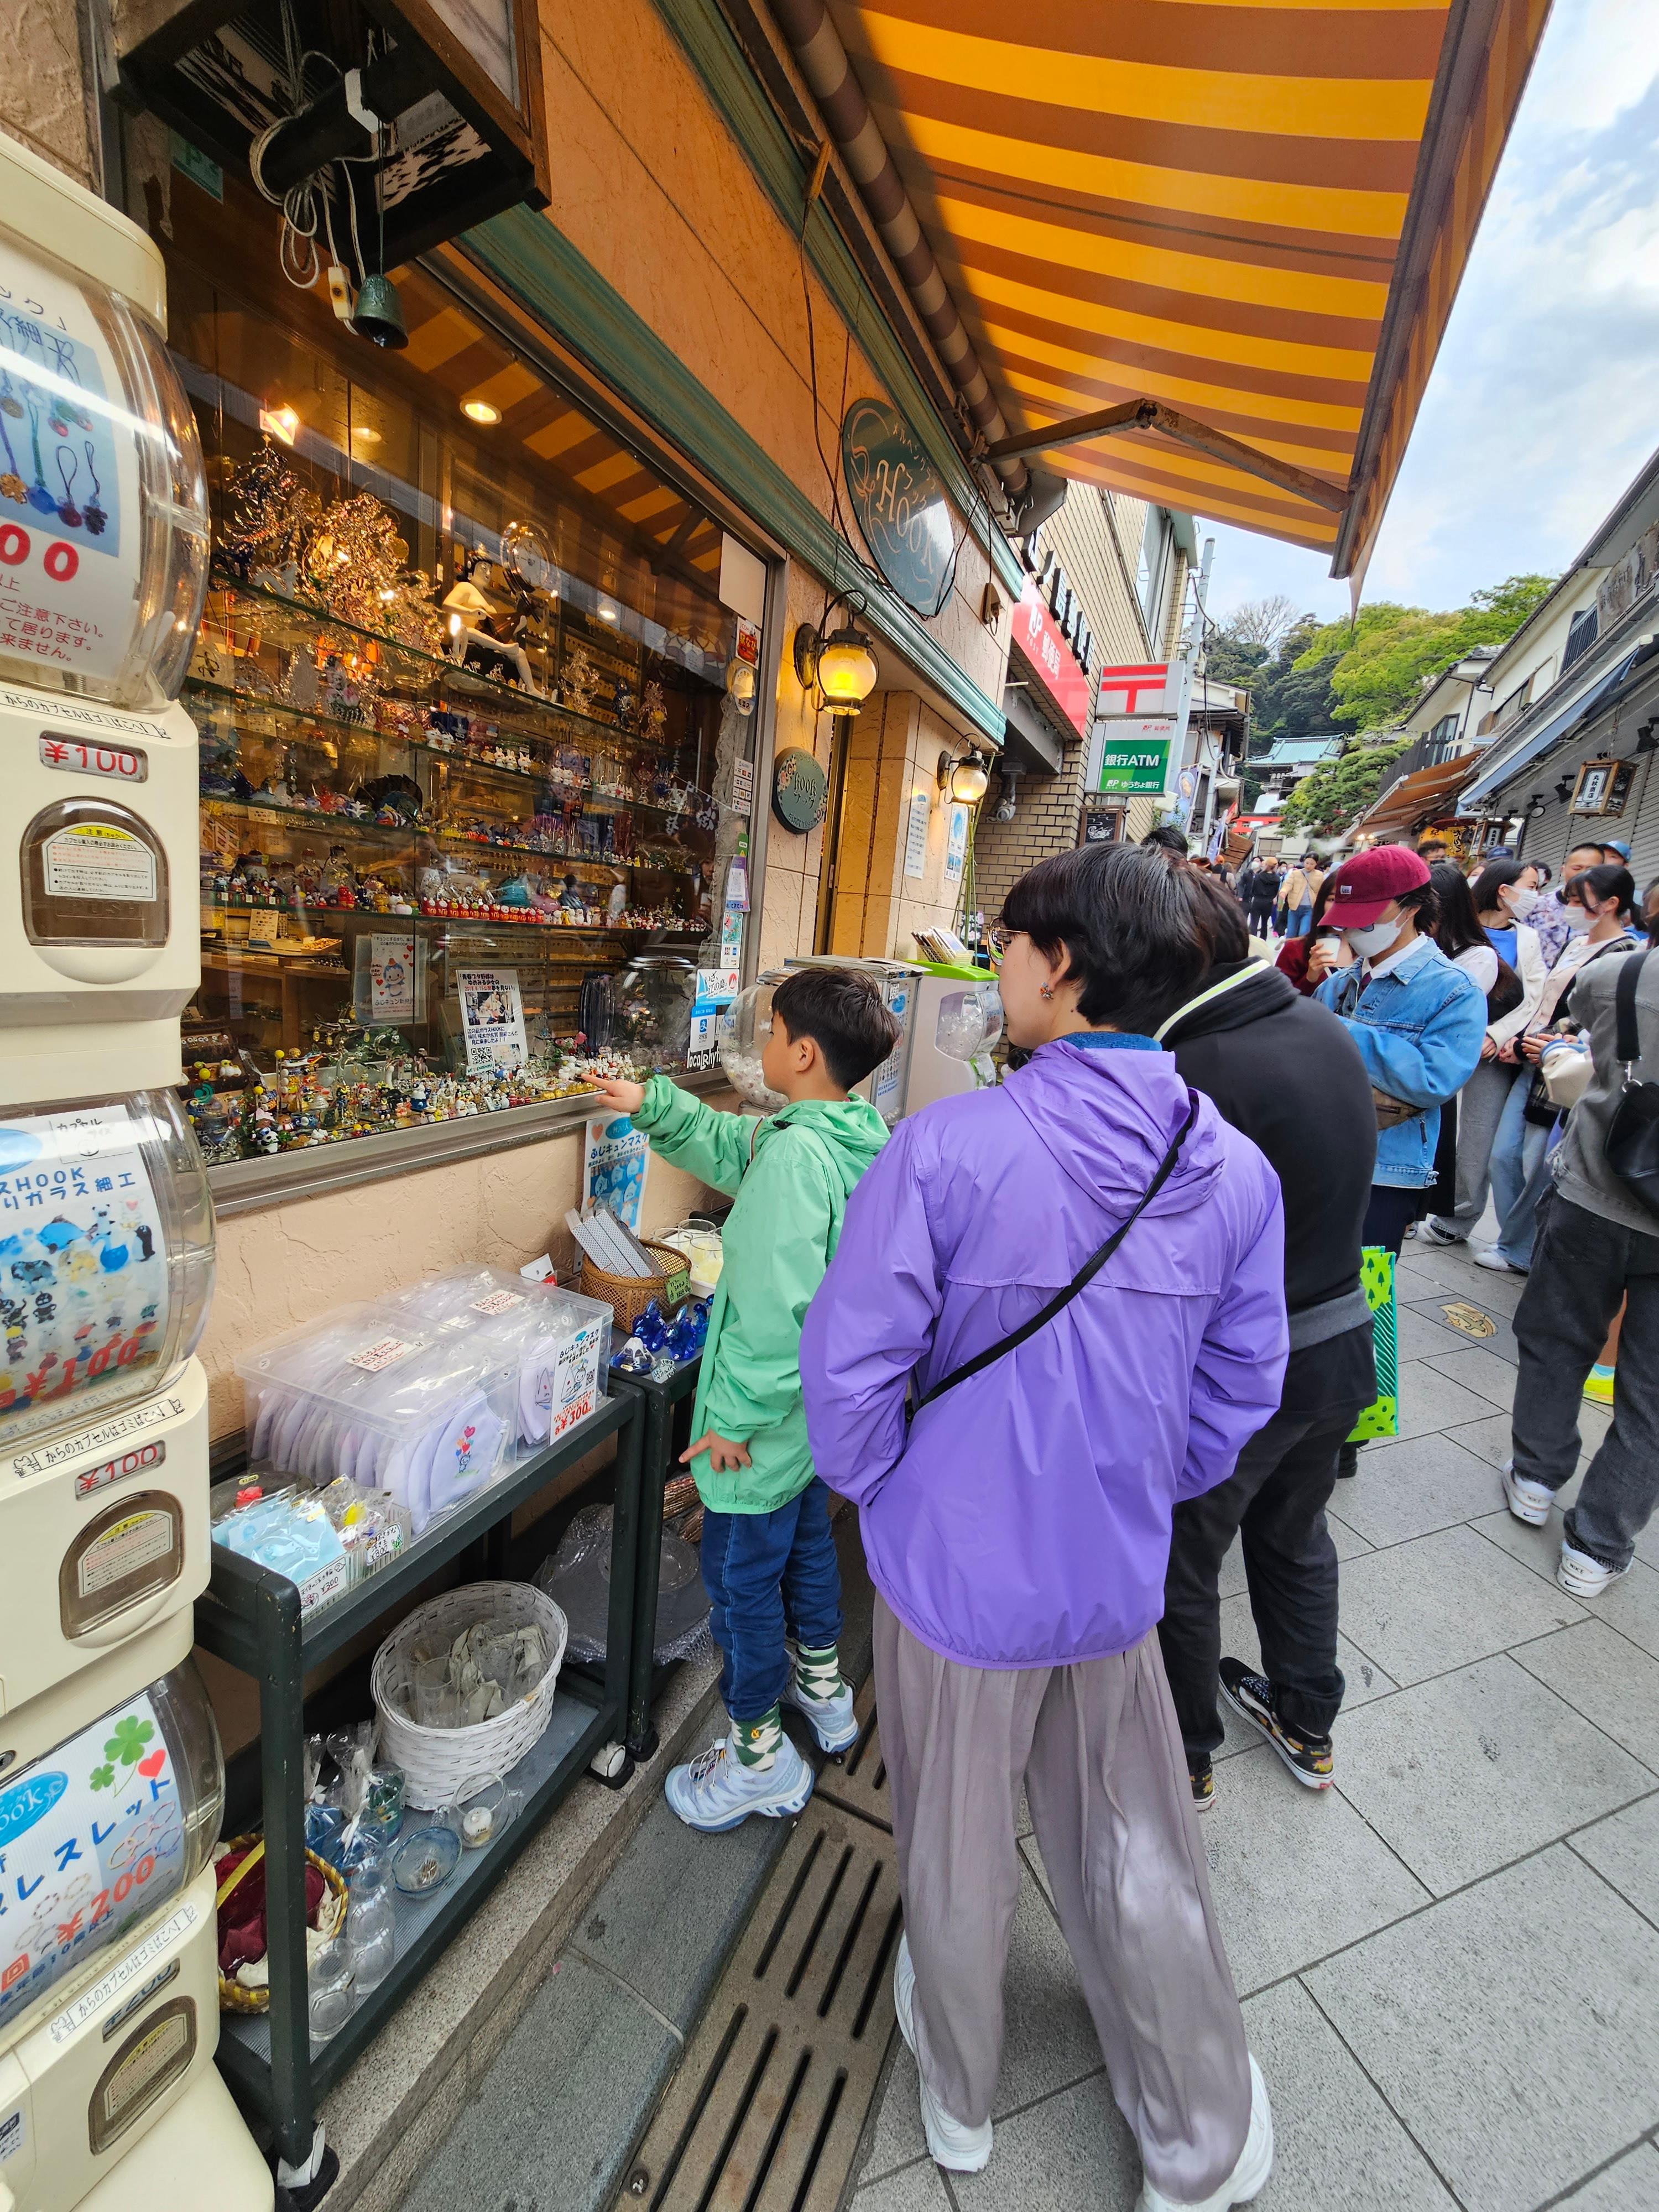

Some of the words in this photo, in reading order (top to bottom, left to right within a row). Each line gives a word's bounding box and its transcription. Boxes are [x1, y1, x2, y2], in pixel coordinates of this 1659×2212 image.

[44, 738, 138, 776] ¥100
[1104, 754, 1160, 767] 銀行ATM
[1121, 781, 1160, 789] ゆうちょ銀行
[4, 1172, 136, 1210] りガラス細工
[22, 1336, 140, 1401] ¥100
[80, 1444, 158, 1491] ¥100
